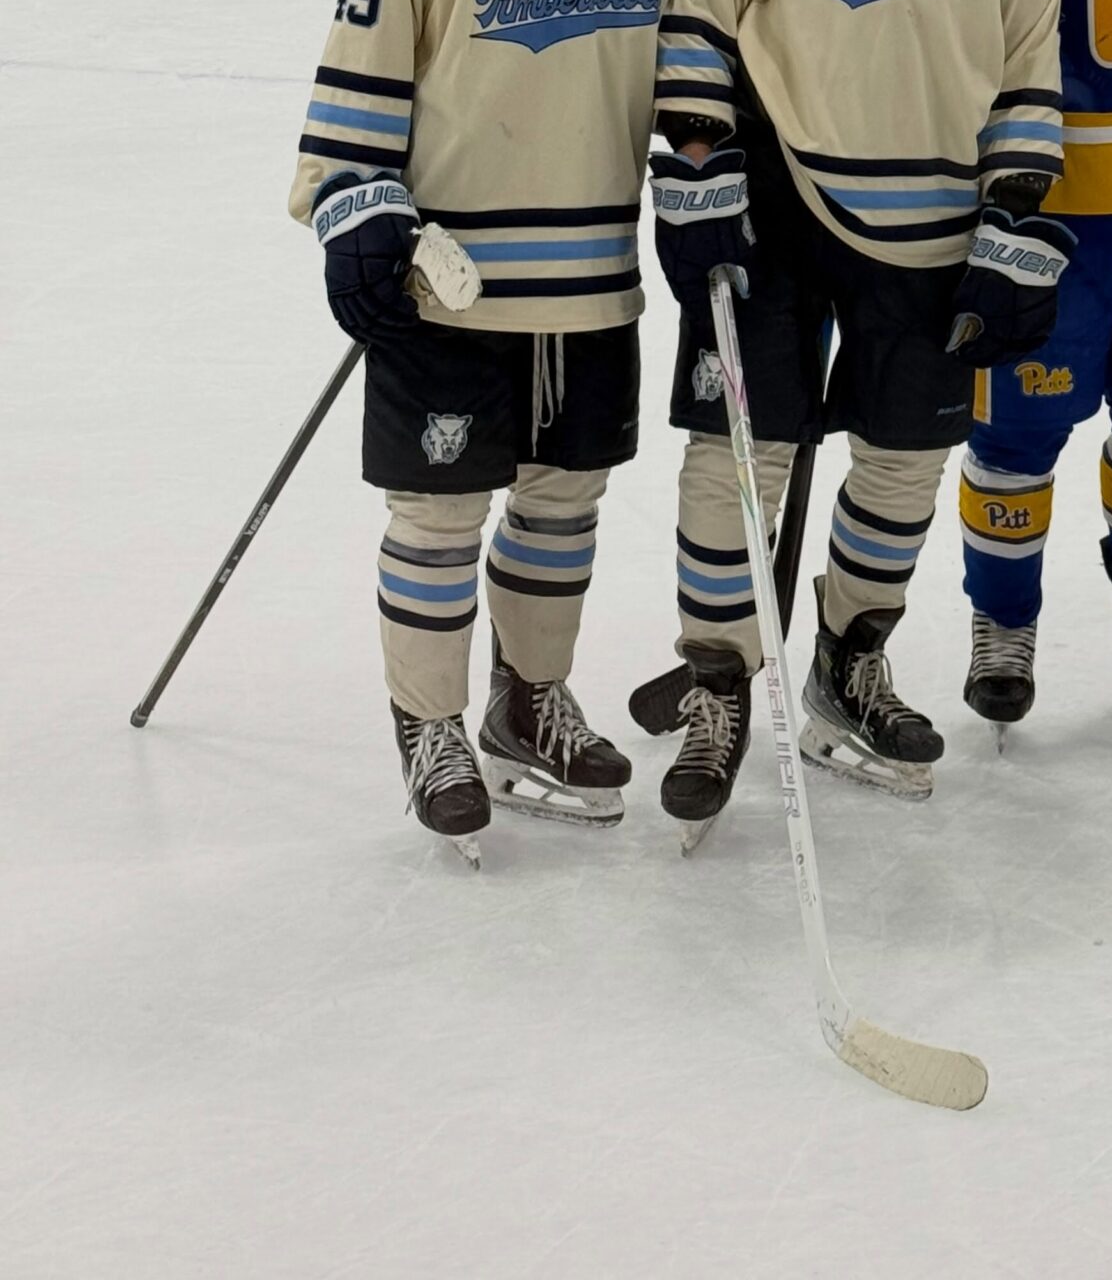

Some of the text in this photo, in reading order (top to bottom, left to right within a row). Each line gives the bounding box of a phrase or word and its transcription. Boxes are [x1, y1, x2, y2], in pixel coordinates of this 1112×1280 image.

[973, 236, 1065, 280] AUER
[1014, 361, 1074, 395] Pitt
[982, 500, 1033, 529] Pitt
